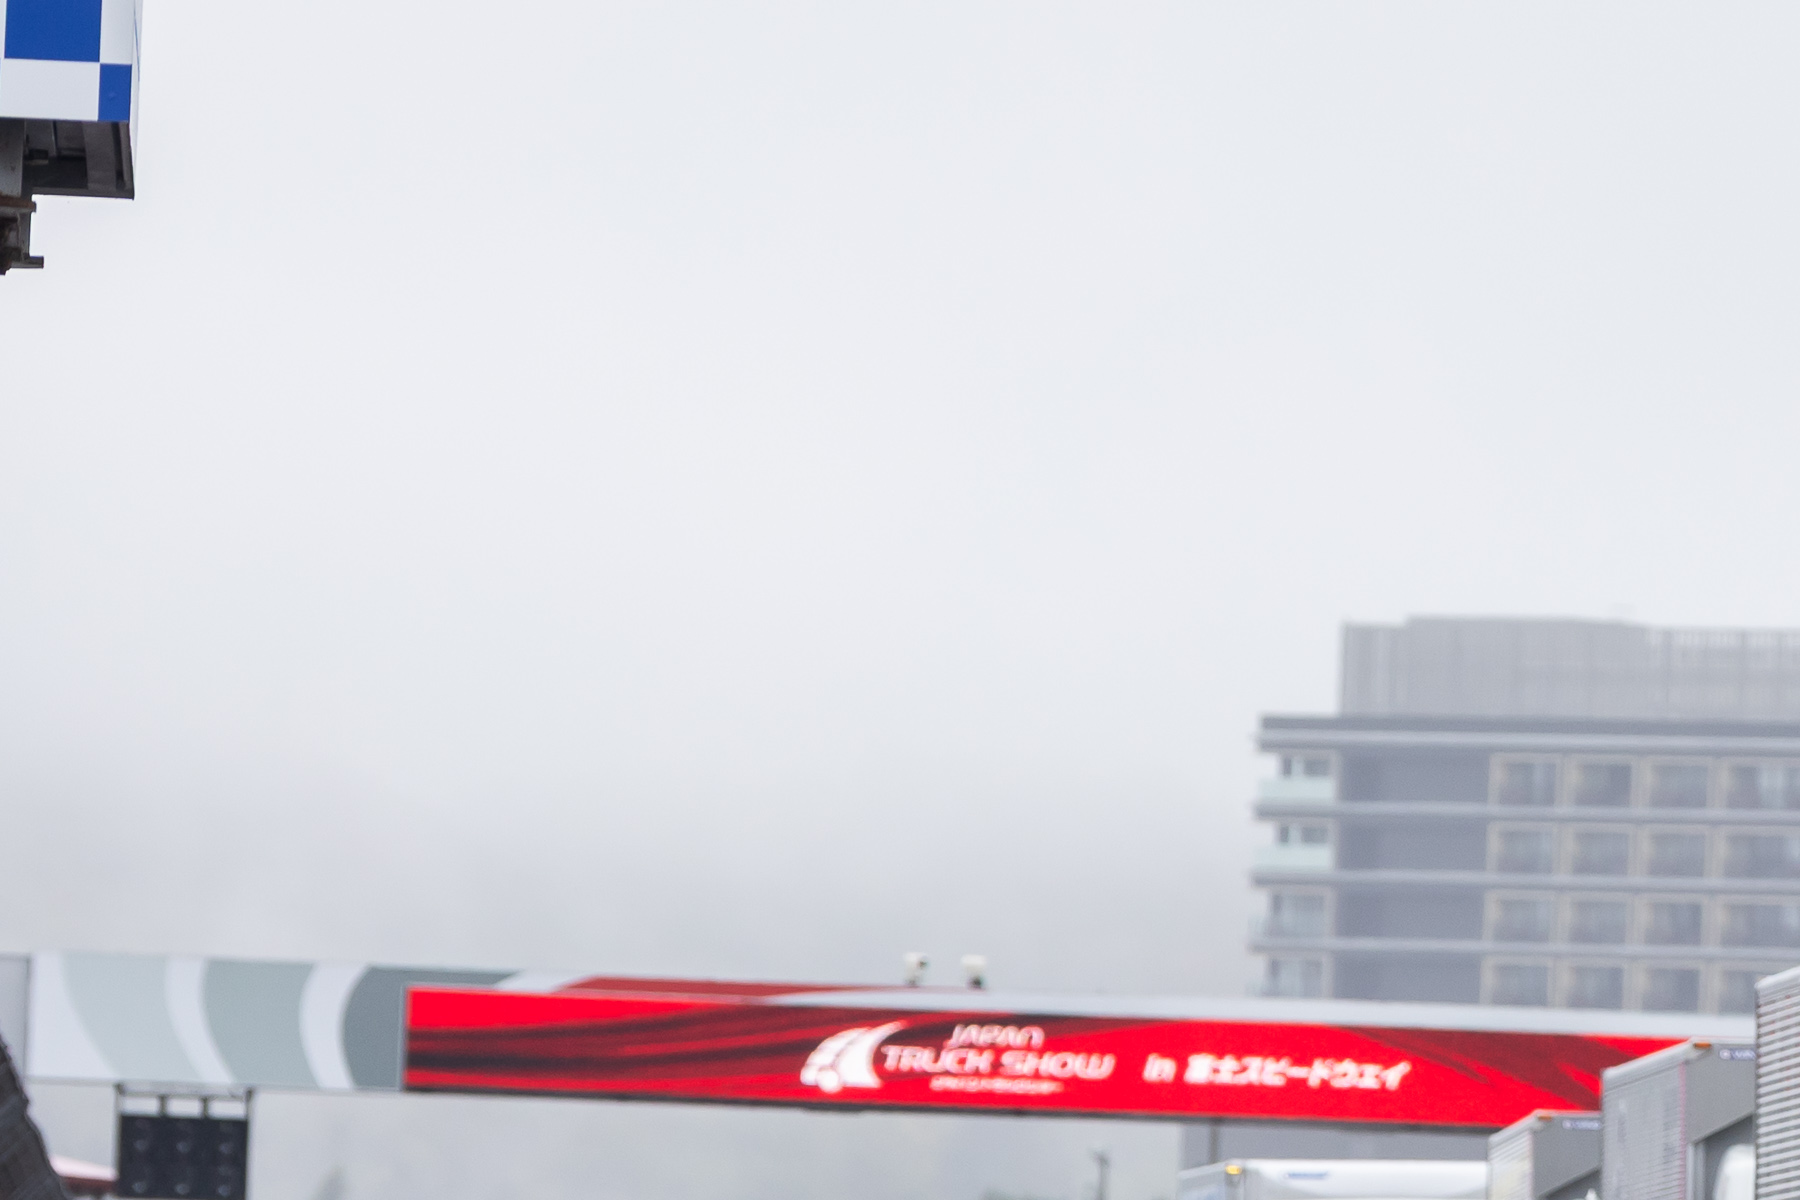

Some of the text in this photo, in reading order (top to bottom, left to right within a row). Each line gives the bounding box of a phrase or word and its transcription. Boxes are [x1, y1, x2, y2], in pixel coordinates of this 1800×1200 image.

[943, 1024, 1046, 1048] JAPAN
[881, 1045, 1117, 1080] TRUCK SHOW
[1142, 1052, 1176, 1083] in
